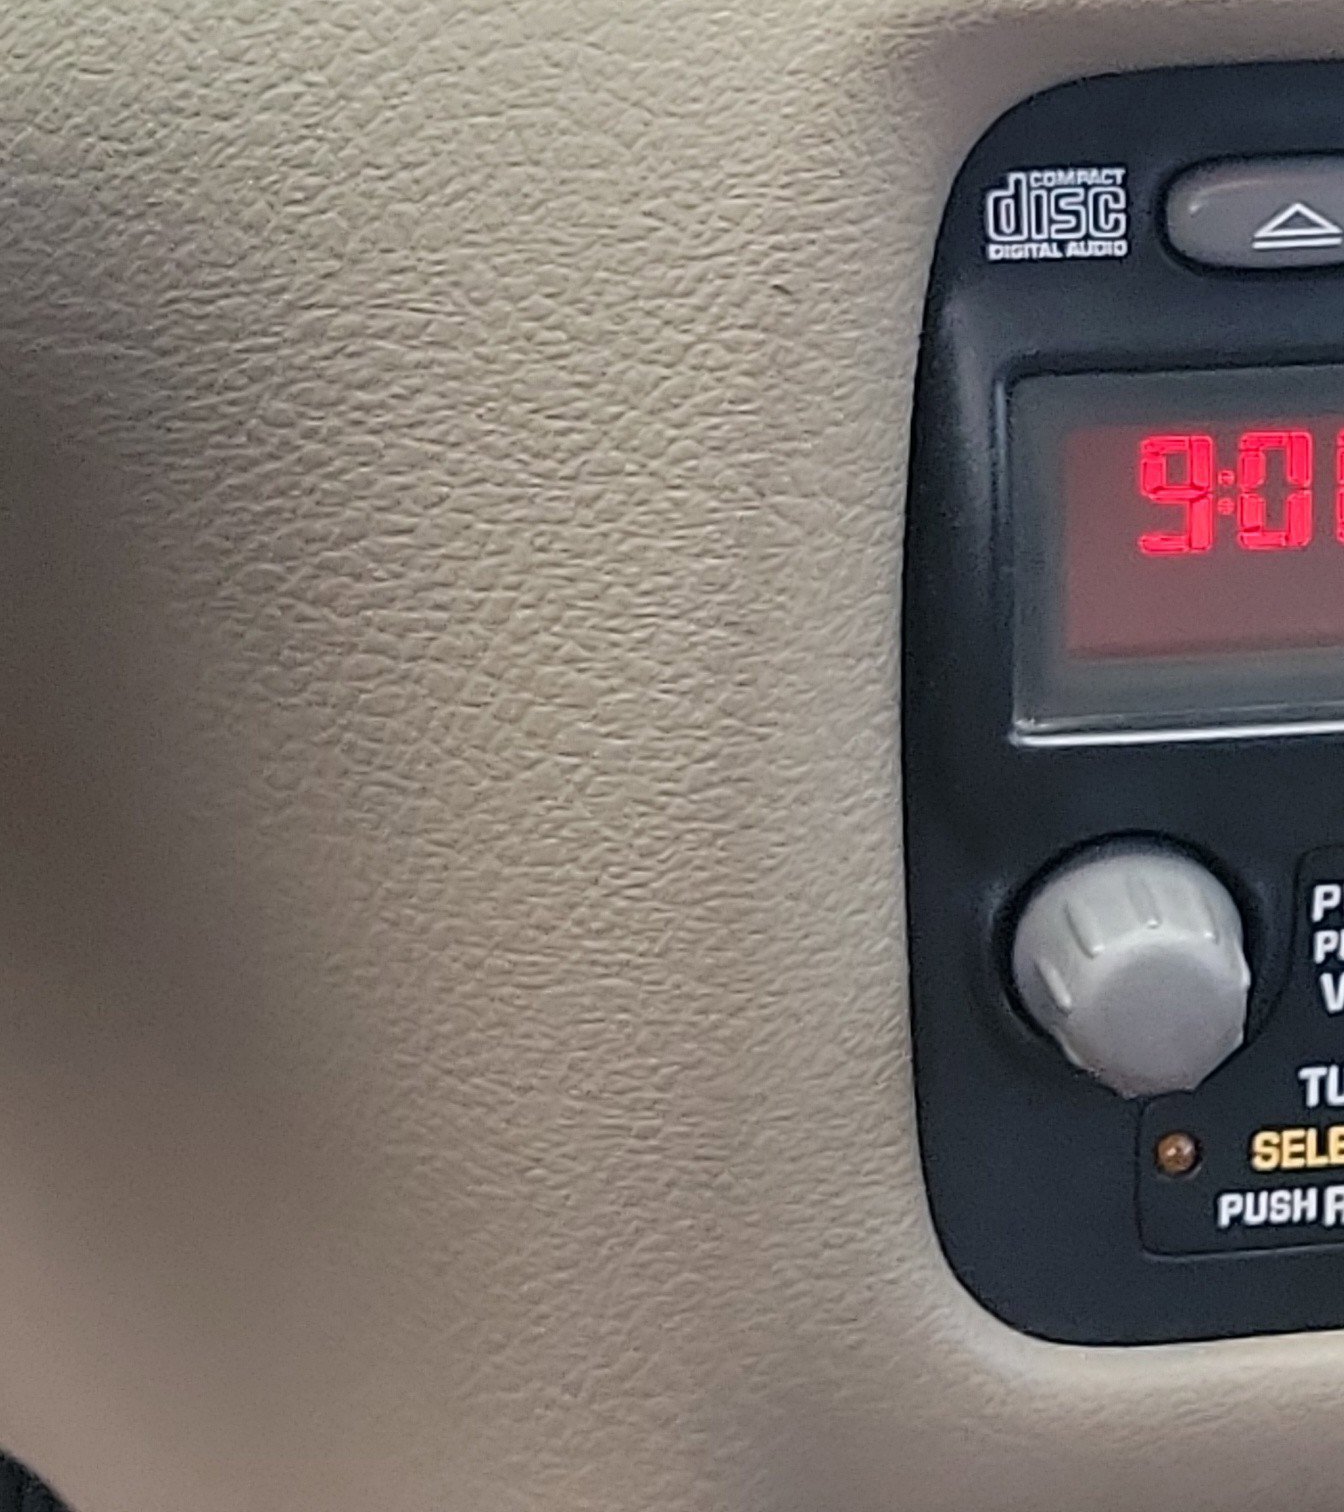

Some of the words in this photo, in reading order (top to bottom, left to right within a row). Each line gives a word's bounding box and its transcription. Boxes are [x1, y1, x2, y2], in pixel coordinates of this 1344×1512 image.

[1030, 168, 1126, 188] COMPACT
[988, 242, 1063, 260] DIGITAL
[1066, 239, 1128, 257] AUDIO
[1217, 1191, 1318, 1229] PUSH
